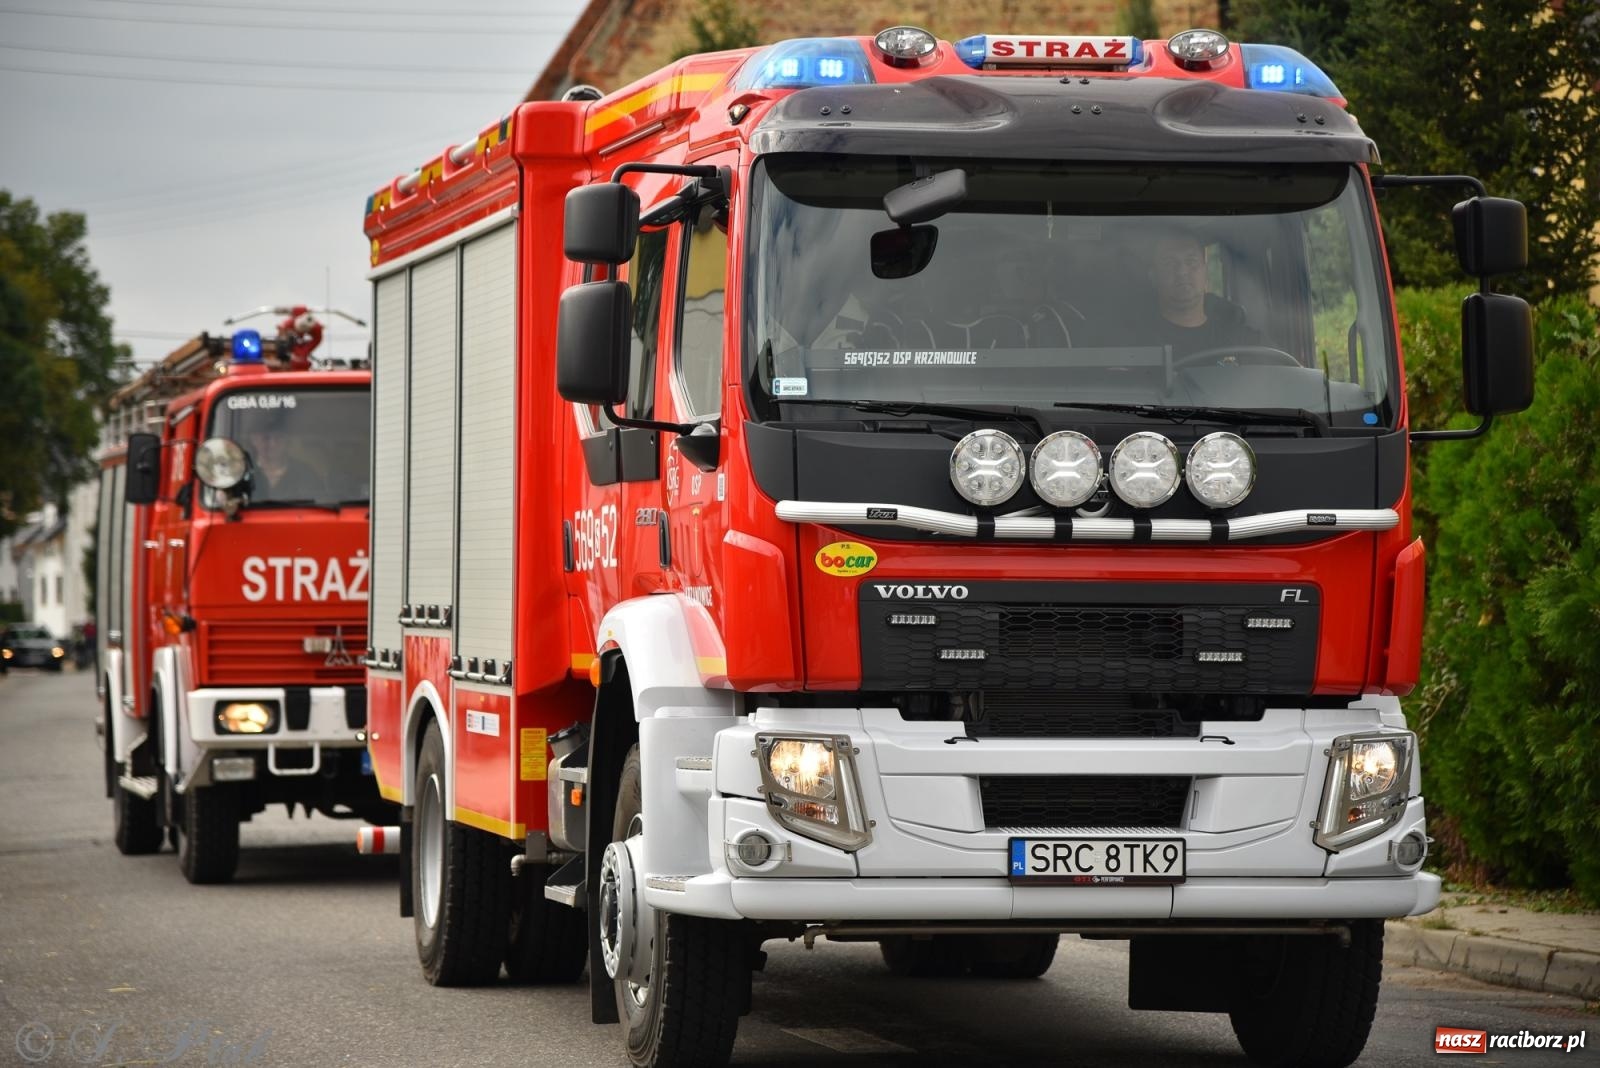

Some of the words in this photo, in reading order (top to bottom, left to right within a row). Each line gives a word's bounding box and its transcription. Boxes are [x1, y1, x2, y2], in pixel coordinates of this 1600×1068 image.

[991, 38, 1127, 58] STRAŻ
[892, 352, 911, 366] OSP
[914, 351, 977, 366] KRZANOWICE
[227, 396, 257, 410] GBA
[820, 552, 875, 568] bocar
[241, 549, 369, 602] STRAŻ
[873, 584, 969, 600] VOLVO
[1280, 588, 1310, 603] FL
[1012, 862, 1024, 870] PL
[1031, 843, 1095, 873] SRC
[1105, 843, 1179, 873] 8TK9
